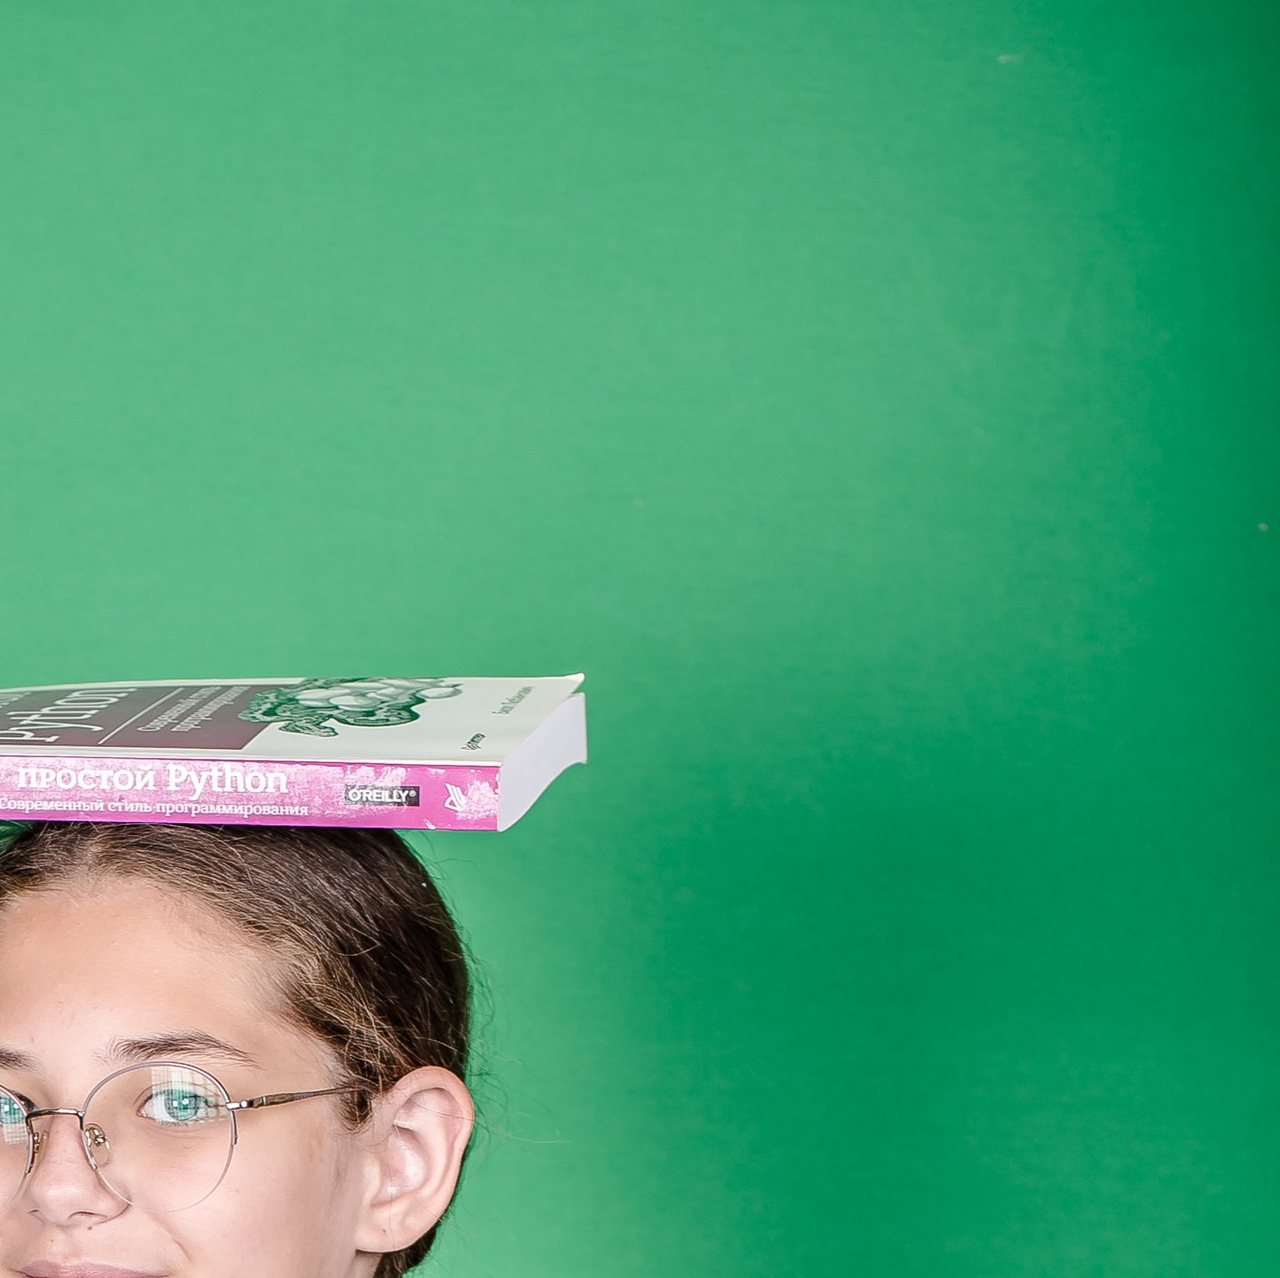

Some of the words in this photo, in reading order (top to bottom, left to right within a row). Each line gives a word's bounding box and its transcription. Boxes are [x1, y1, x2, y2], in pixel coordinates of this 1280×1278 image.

[167, 763, 289, 801] Python
[108, 801, 152, 813] стиль
[155, 802, 309, 818] программирования
